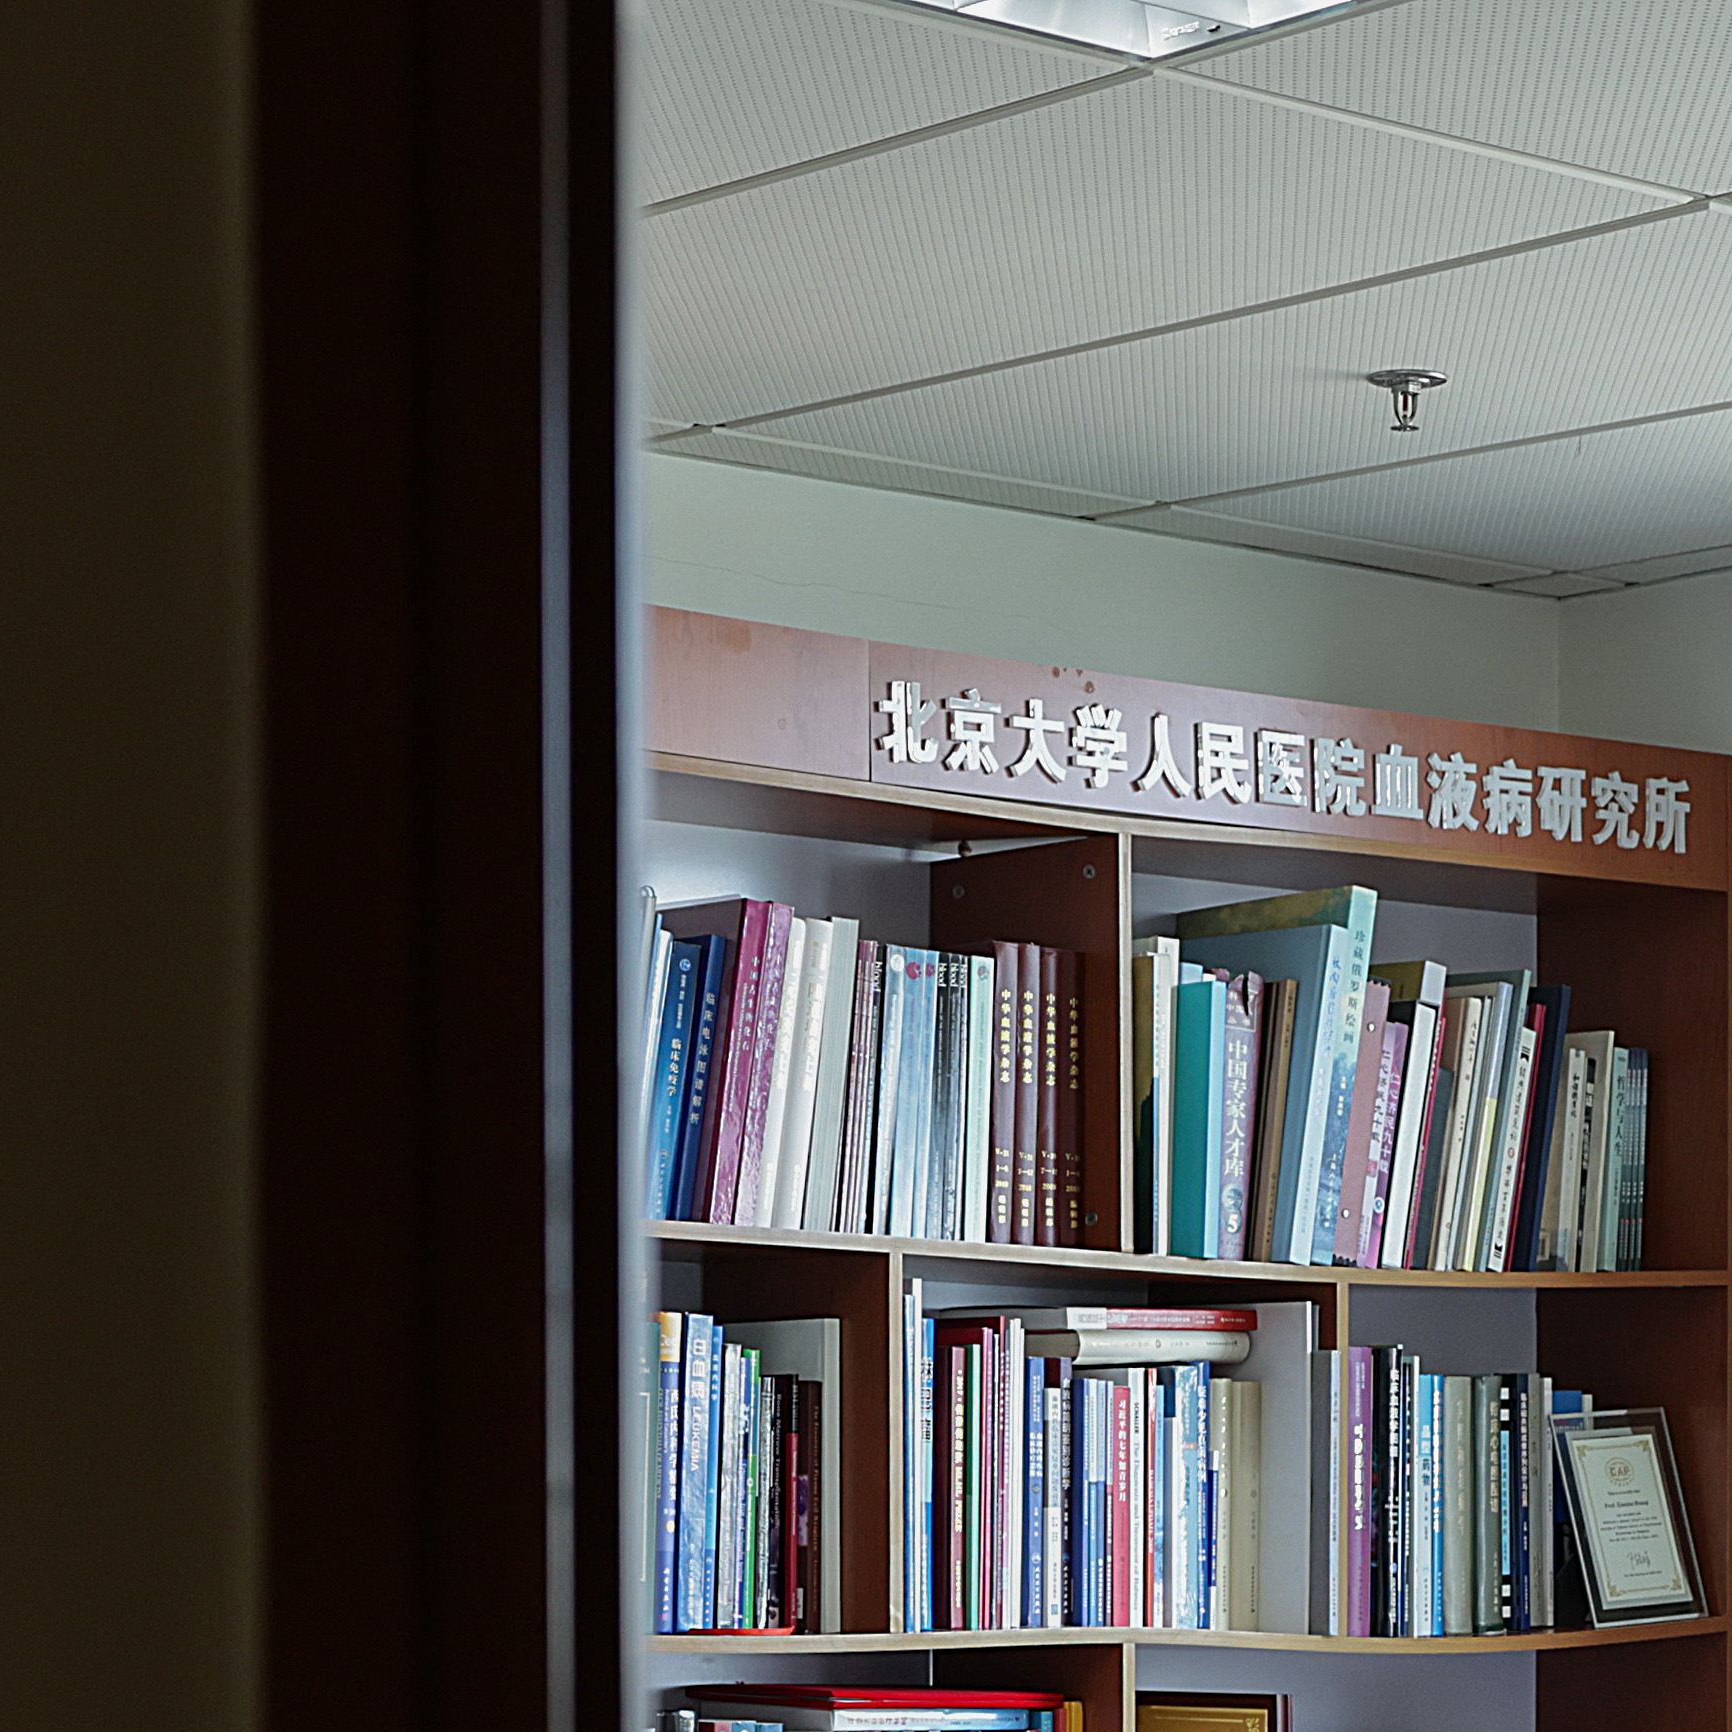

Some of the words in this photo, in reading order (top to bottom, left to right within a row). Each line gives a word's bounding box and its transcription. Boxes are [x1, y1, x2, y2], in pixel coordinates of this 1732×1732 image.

[878, 680, 1692, 856] 北京大学人民医院血液病研究所
[873, 961, 883, 993] blood
[938, 962, 947, 988] blood
[950, 962, 959, 988] blood
[1343, 930, 1366, 1045] 珍藏俄罗斯绘画
[666, 1038, 682, 1097] 临床免疫学
[689, 992, 716, 1126] 临床电泳图谱解析
[1000, 989, 1012, 1083] 中华血液学杂志
[1022, 990, 1034, 1084] 中华血液学杂志
[1046, 993, 1056, 1087] 中华血液学杂志
[1069, 997, 1079, 1090] 中华血液学杂志
[1224, 1040, 1248, 1178] 中国专家人才库
[1371, 1050, 1391, 1144] 仁心济民九十载
[1379, 1074, 1401, 1174] 仁心济民九十载
[1616, 1075, 1626, 1158] 哲学与人生
[1227, 1213, 1239, 1234] 5
[691, 1405, 702, 1472] LEUKEMIA
[1117, 1399, 1127, 1502] 习近平的七年知青岁月
